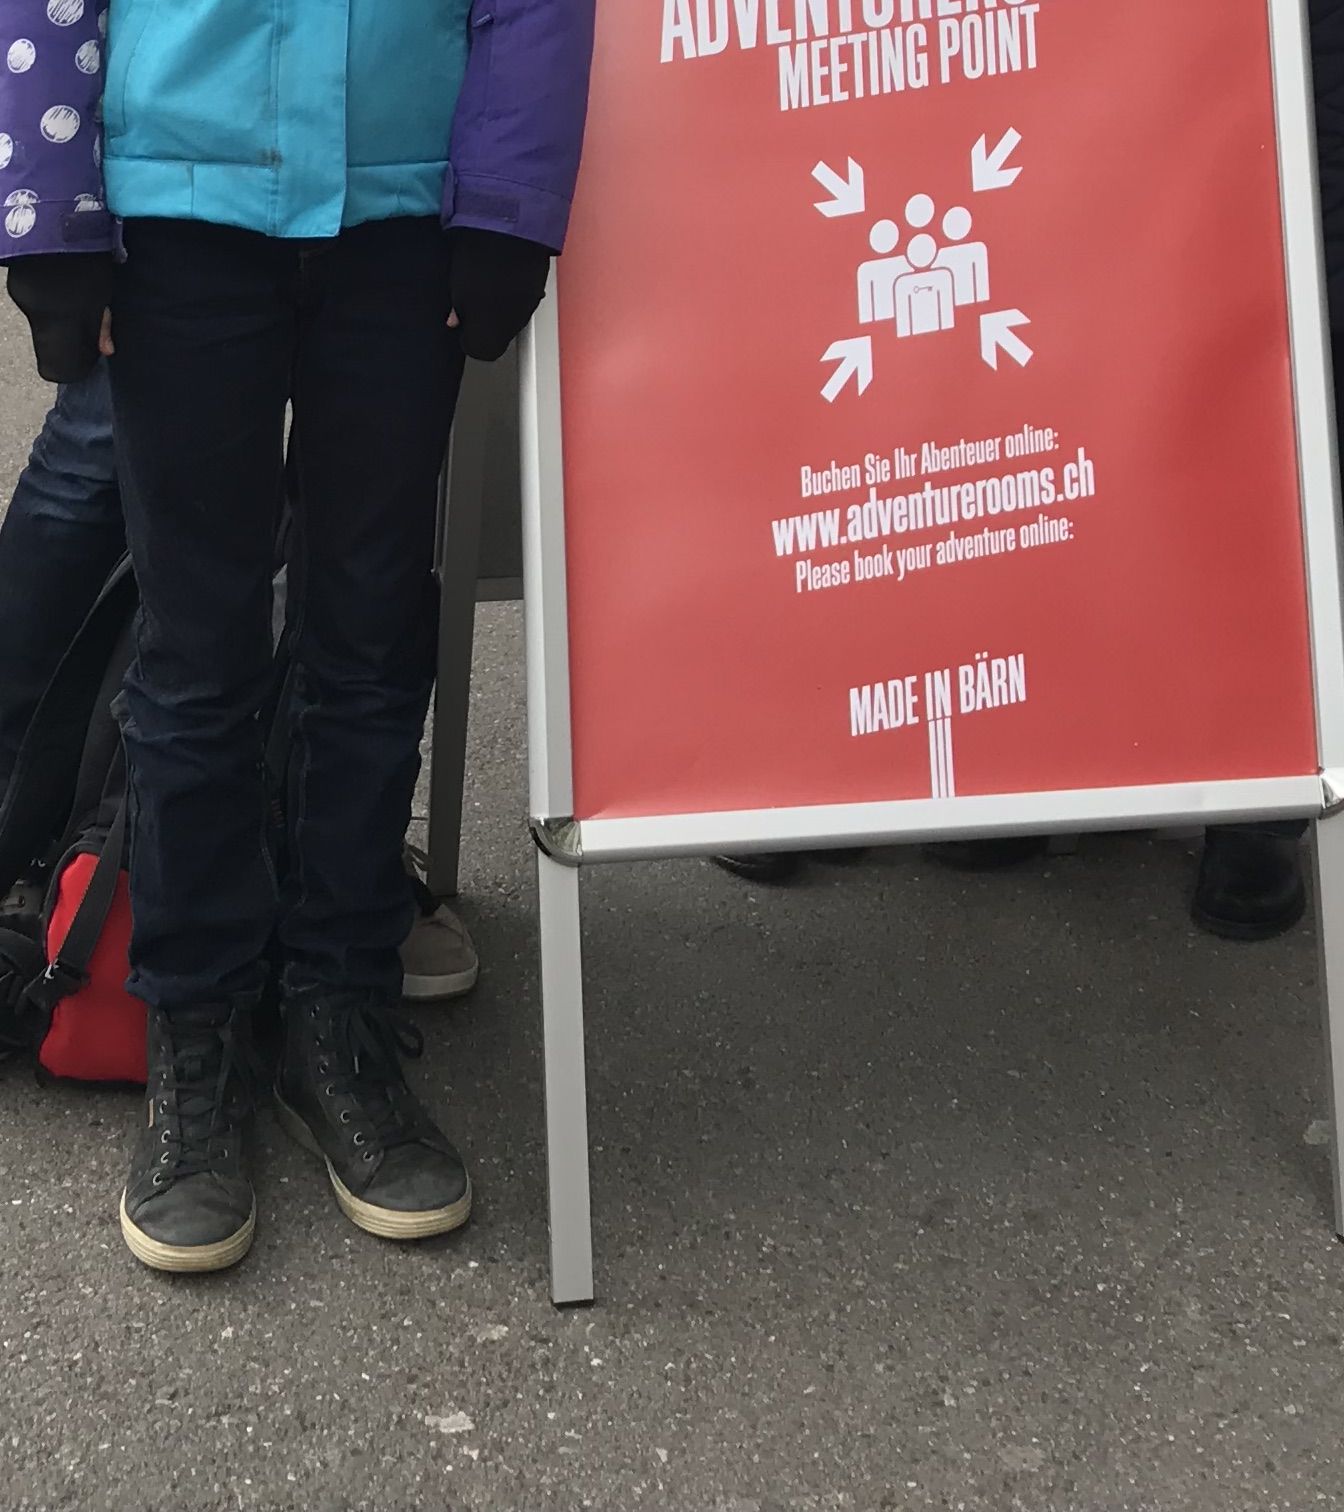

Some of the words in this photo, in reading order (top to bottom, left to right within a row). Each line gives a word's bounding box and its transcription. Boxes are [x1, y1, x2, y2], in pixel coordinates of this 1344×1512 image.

[777, 22, 930, 113] MEETING
[938, 3, 1041, 85] POINT
[771, 446, 1096, 557] www.adventurerooms.ch
[800, 460, 862, 499] Buchen
[864, 452, 892, 486] Sie
[894, 446, 918, 481] Ihr
[920, 436, 1003, 475] Abenteuer
[1004, 423, 1060, 459] online:
[795, 556, 852, 594] Please
[853, 543, 894, 582] book
[896, 544, 934, 582] your
[935, 526, 1017, 565] adventure
[1019, 513, 1075, 549] online:
[849, 676, 920, 737] MADE
[924, 668, 953, 721] IN
[958, 651, 1028, 715] BÄRN
